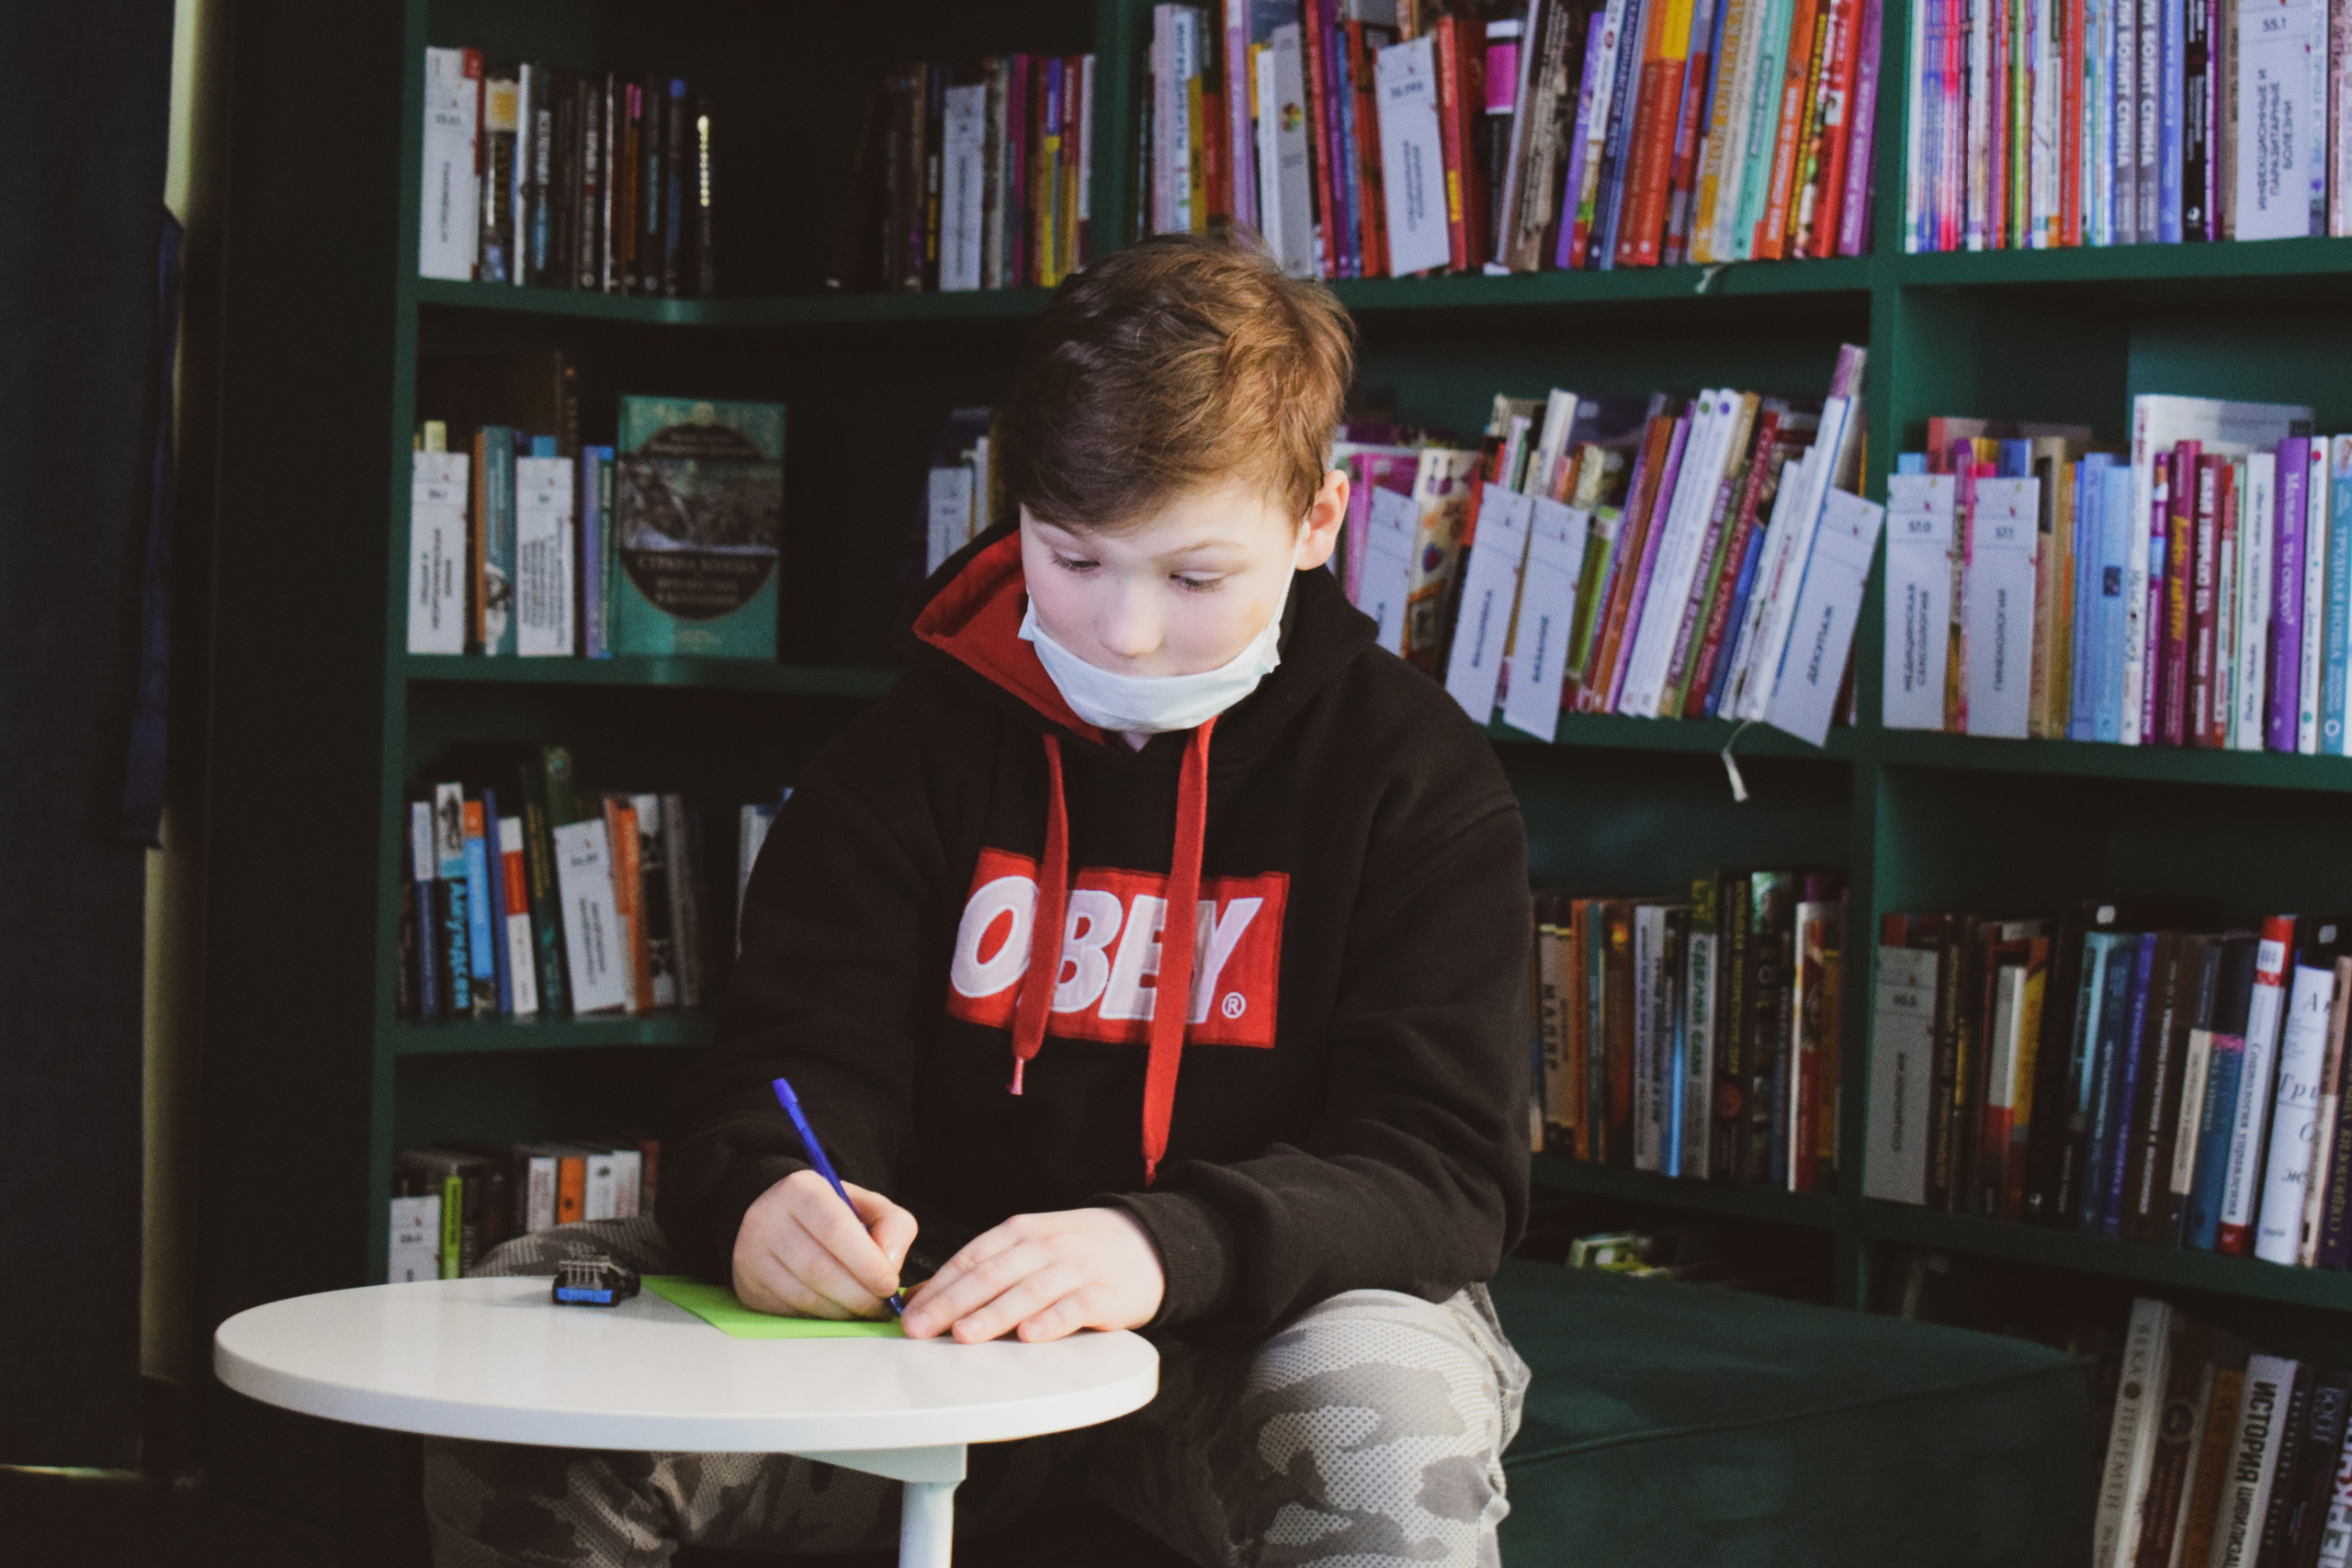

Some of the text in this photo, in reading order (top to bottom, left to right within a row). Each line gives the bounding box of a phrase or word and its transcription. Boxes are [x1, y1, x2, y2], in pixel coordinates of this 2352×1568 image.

[2116, 30, 2131, 94] БОЛИТ
[2141, 30, 2154, 94] БОЛИТ
[2116, 99, 2131, 167] СПИНА
[2140, 99, 2154, 167] СПИНА
[2256, 85, 2267, 211] ИНФЕКЦИОННЫЕ
[2269, 82, 2280, 197] ПАРАЗИТАРНЫЕ
[2282, 100, 2292, 171] БОЛЕЗНИ
[2278, 566, 2295, 625] скоро?
[2332, 524, 2347, 600] ТРУДНАЯ
[950, 875, 1263, 1023] OBEY
[2227, 1132, 2247, 1217] управления
[2105, 1405, 2137, 1509] ПЕРЕМЕН
[2235, 1382, 2278, 1484] ИСТОРИЯ
